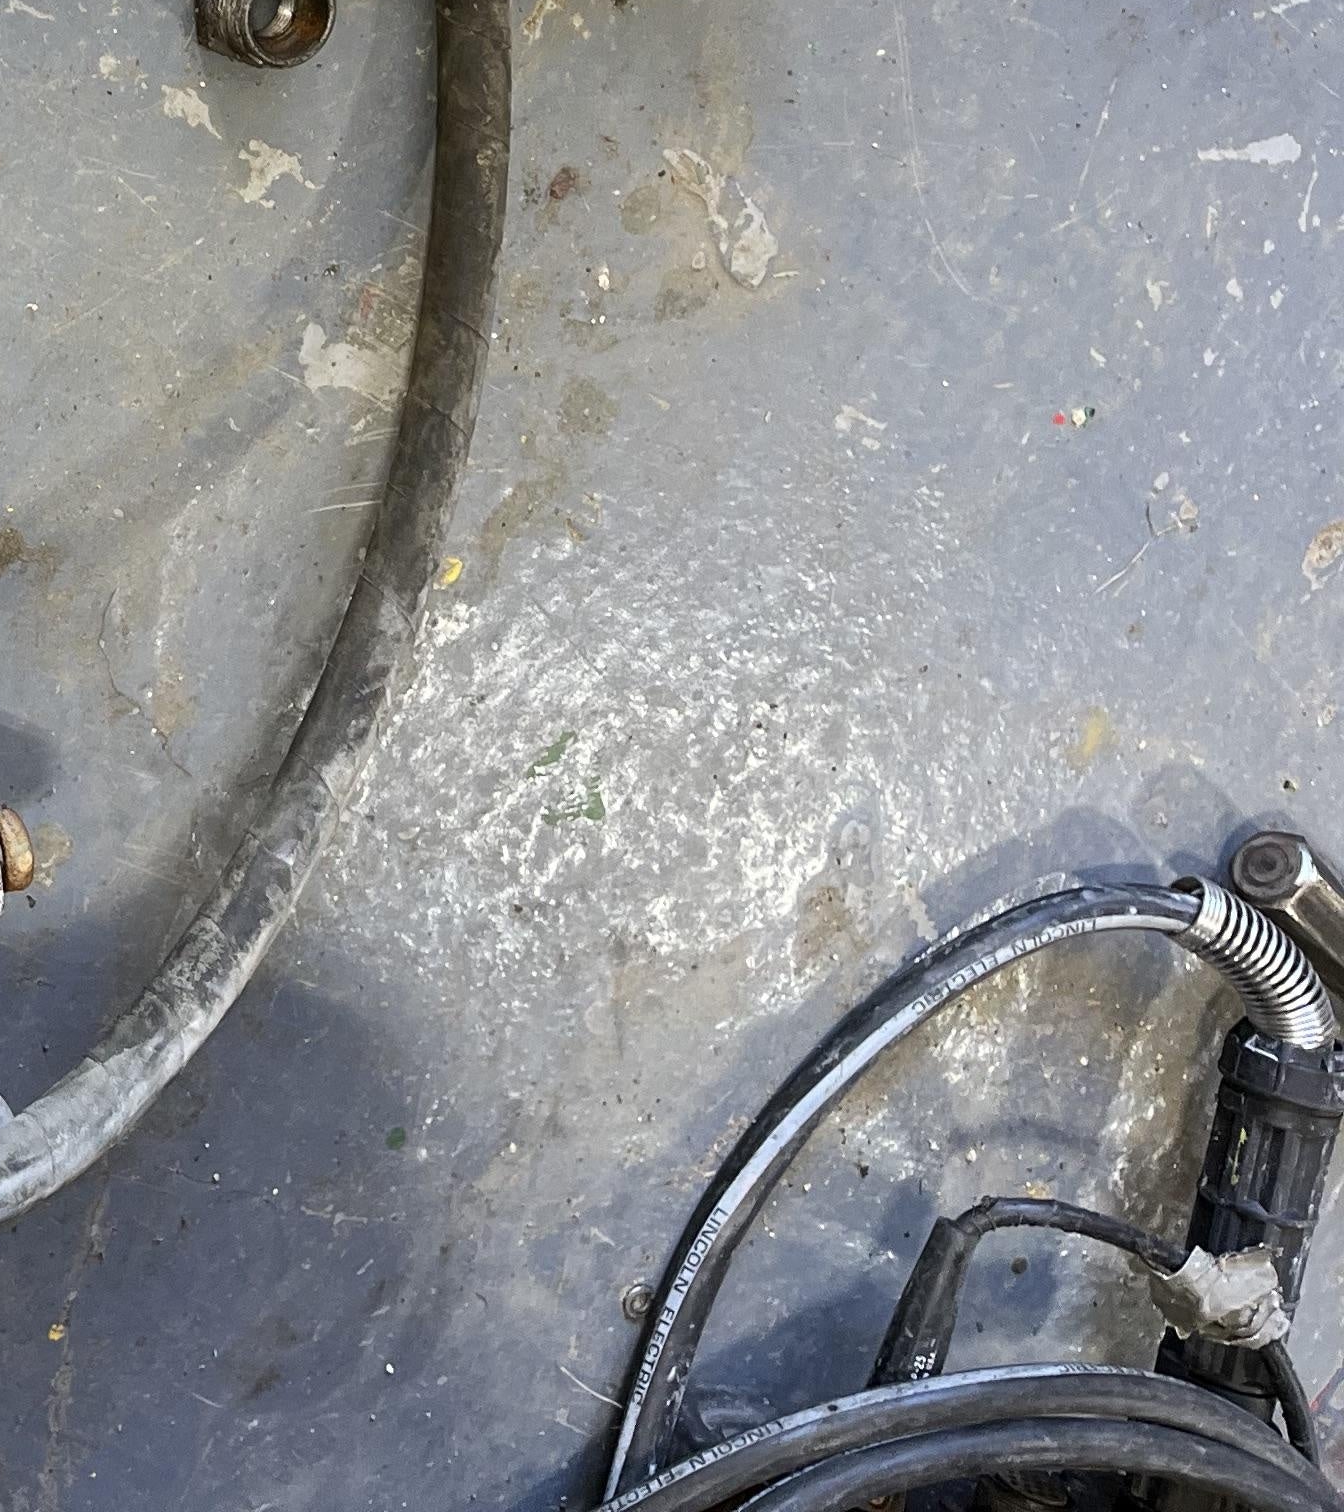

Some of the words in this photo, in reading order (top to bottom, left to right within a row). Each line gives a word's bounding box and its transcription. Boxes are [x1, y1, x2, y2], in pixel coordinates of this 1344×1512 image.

[1012, 918, 1097, 957] LINCOLN
[911, 954, 1000, 1015] ELECTRIC
[672, 1207, 730, 1295] LINCOLN
[632, 1305, 676, 1408] ELECTRIC
[688, 1419, 786, 1472] LINCOLN
